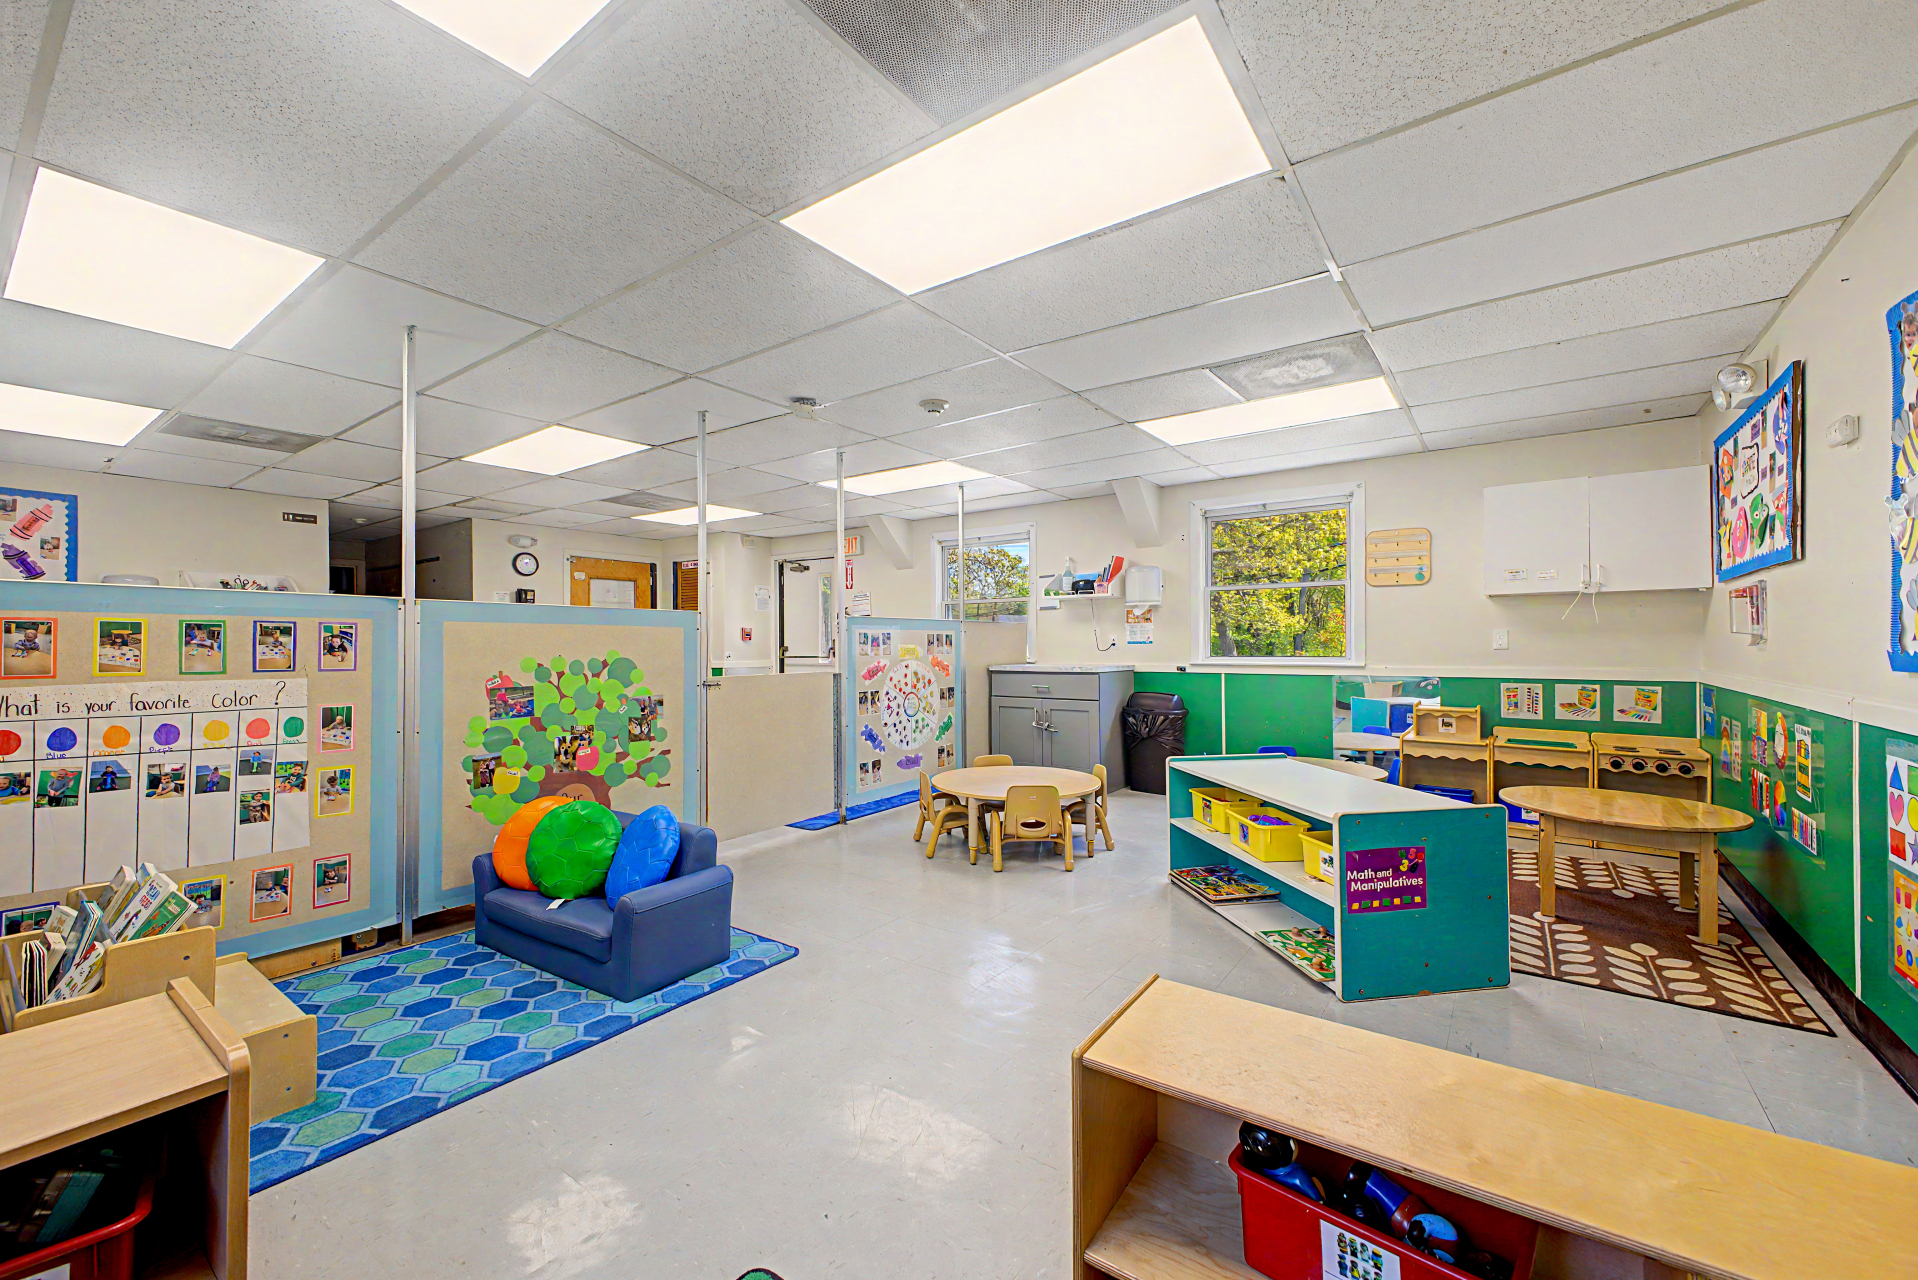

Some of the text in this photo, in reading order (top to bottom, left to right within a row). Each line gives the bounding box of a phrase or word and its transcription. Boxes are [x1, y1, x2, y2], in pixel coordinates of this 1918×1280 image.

[56, 701, 70, 714] is
[85, 700, 117, 715] your
[130, 693, 191, 711] favorite
[212, 690, 258, 708] Color
[1347, 868, 1392, 881] Math and
[1350, 876, 1424, 892] Manipulatives
